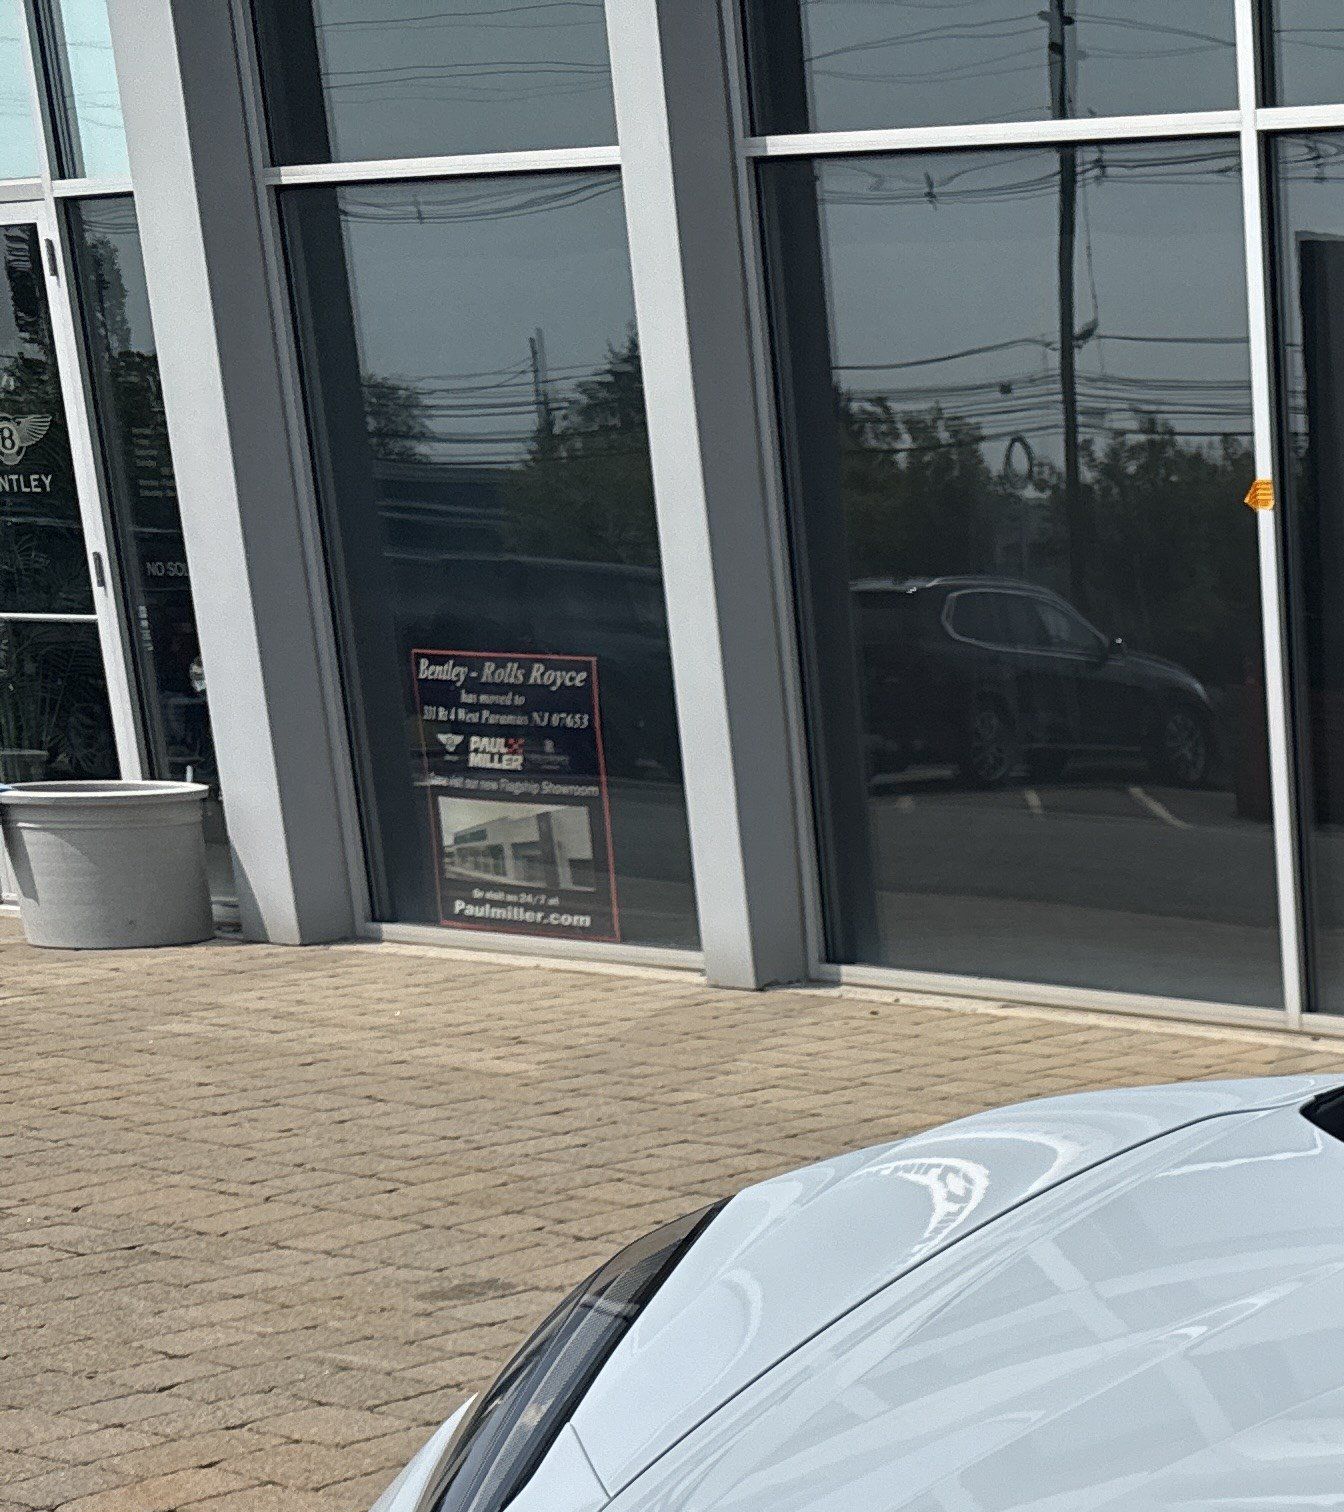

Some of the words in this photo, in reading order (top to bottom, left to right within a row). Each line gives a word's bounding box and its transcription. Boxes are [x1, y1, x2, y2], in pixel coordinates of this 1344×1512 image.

[146, 561, 165, 576] NO
[418, 657, 468, 686] Bentley
[480, 661, 525, 685] Rolls
[527, 662, 588, 691] Royce
[531, 711, 550, 727] NJ
[469, 735, 507, 753] PAUL
[468, 753, 525, 771] MILLER
[453, 899, 592, 928] Paulmiller.com
